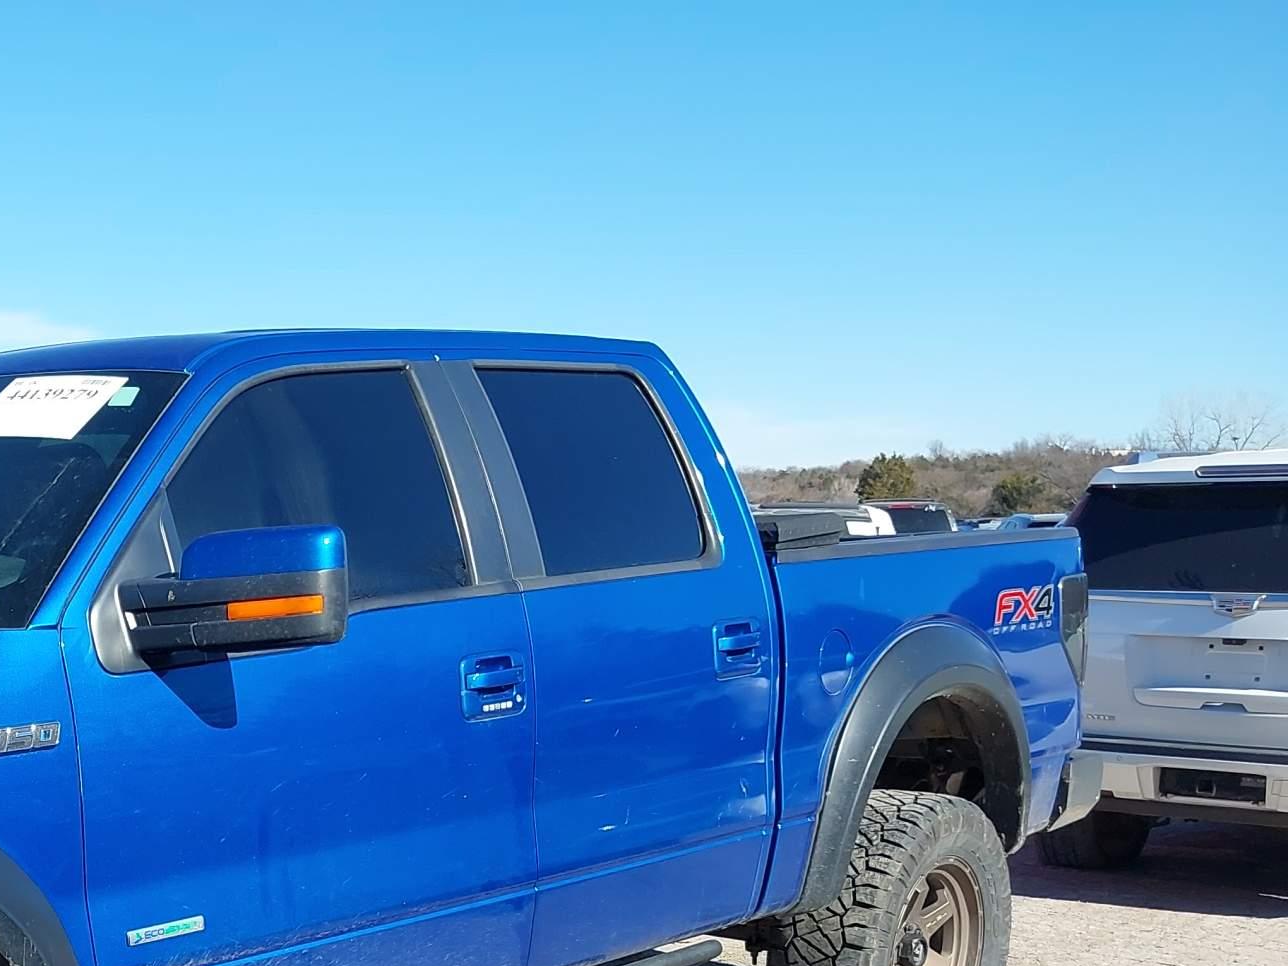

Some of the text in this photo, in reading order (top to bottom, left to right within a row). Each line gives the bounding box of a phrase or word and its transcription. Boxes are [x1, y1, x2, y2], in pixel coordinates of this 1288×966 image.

[6, 388, 99, 401] 44139279
[994, 584, 1054, 627] FX4
[993, 619, 1053, 636] OFF ROAD
